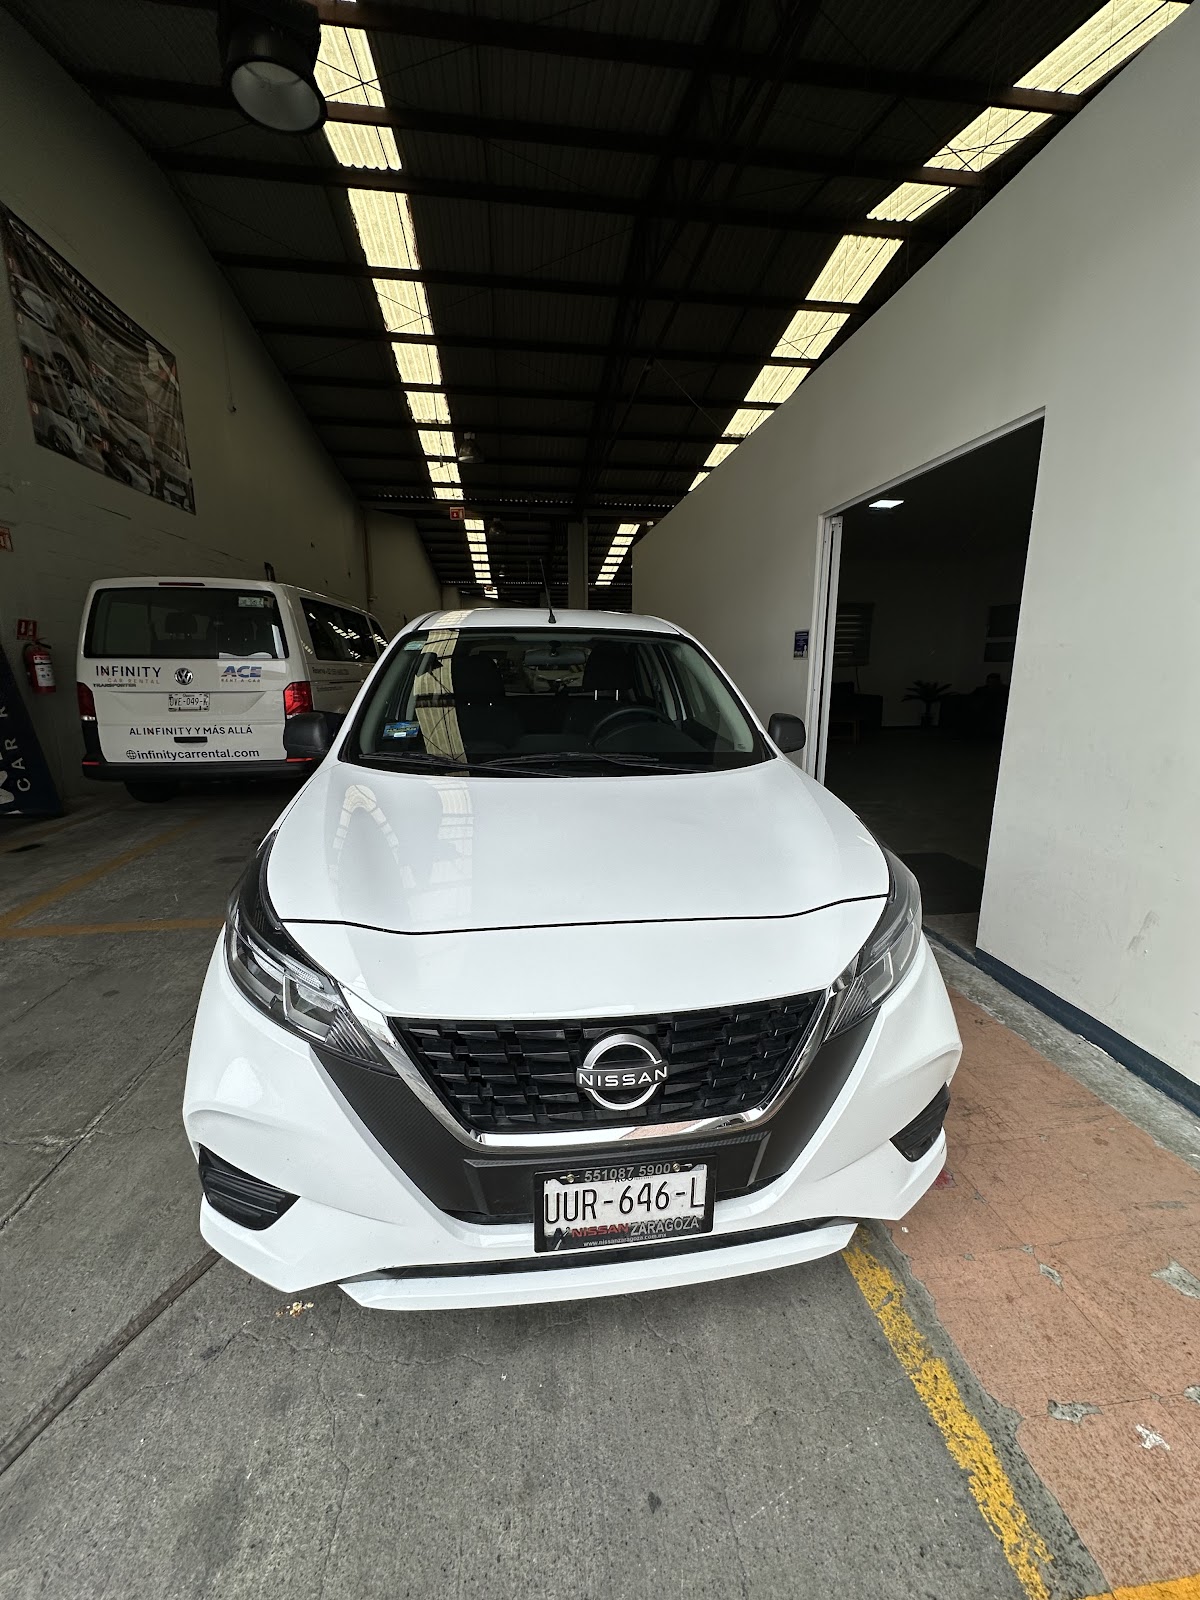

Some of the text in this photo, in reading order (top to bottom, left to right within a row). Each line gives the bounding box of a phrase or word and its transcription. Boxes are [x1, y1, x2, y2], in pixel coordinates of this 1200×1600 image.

[96, 665, 161, 677] INFINITY
[221, 665, 262, 678] ACE
[129, 724, 253, 735] AL INFINITY Y MÁS ALLÁ
[136, 749, 260, 760] infinitycarrental.com
[579, 1066, 668, 1087] NISSAN
[584, 1167, 635, 1182] 551087
[639, 1163, 671, 1177] 5900
[545, 1177, 705, 1224] UUR-646-L
[630, 1215, 699, 1236] ZARAGOZA
[583, 1232, 667, 1247] www.nissanzaragoza.com.mx
